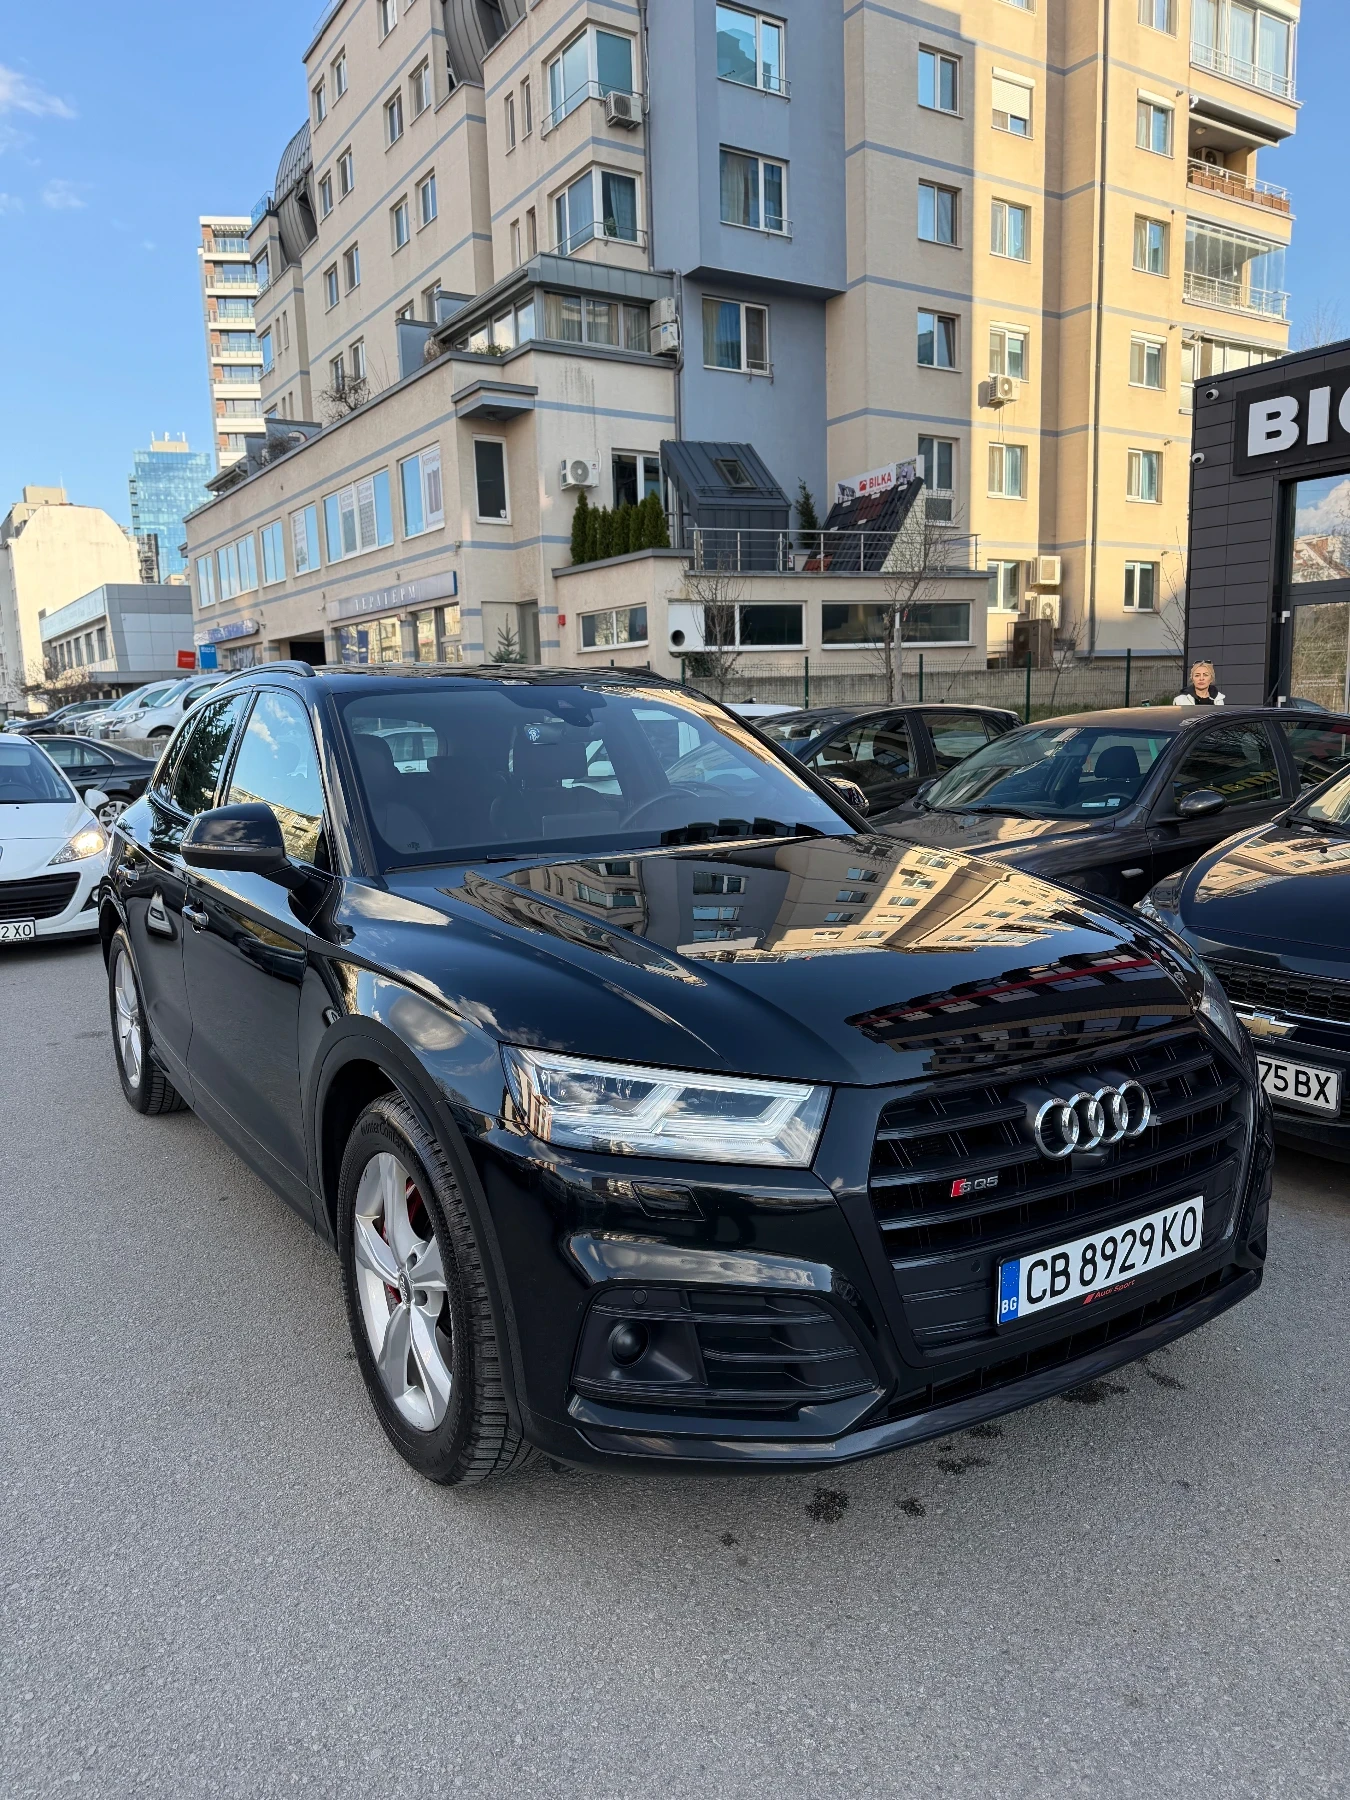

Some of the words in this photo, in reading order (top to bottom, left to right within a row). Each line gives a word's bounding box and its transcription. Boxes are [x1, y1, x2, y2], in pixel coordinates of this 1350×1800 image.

[1247, 386, 1350, 457] BI
[868, 472, 892, 489] BILKA
[13, 923, 32, 938] XO
[1294, 1068, 1332, 1104] BX
[957, 1175, 999, 1194] SQ5
[1026, 1251, 1071, 1305] CB
[1079, 1222, 1156, 1287] 8929
[1160, 1206, 1198, 1258] KO
[1093, 1287, 1113, 1299] Audi
[1114, 1279, 1136, 1292] Sport
[1001, 1296, 1018, 1314] BG
